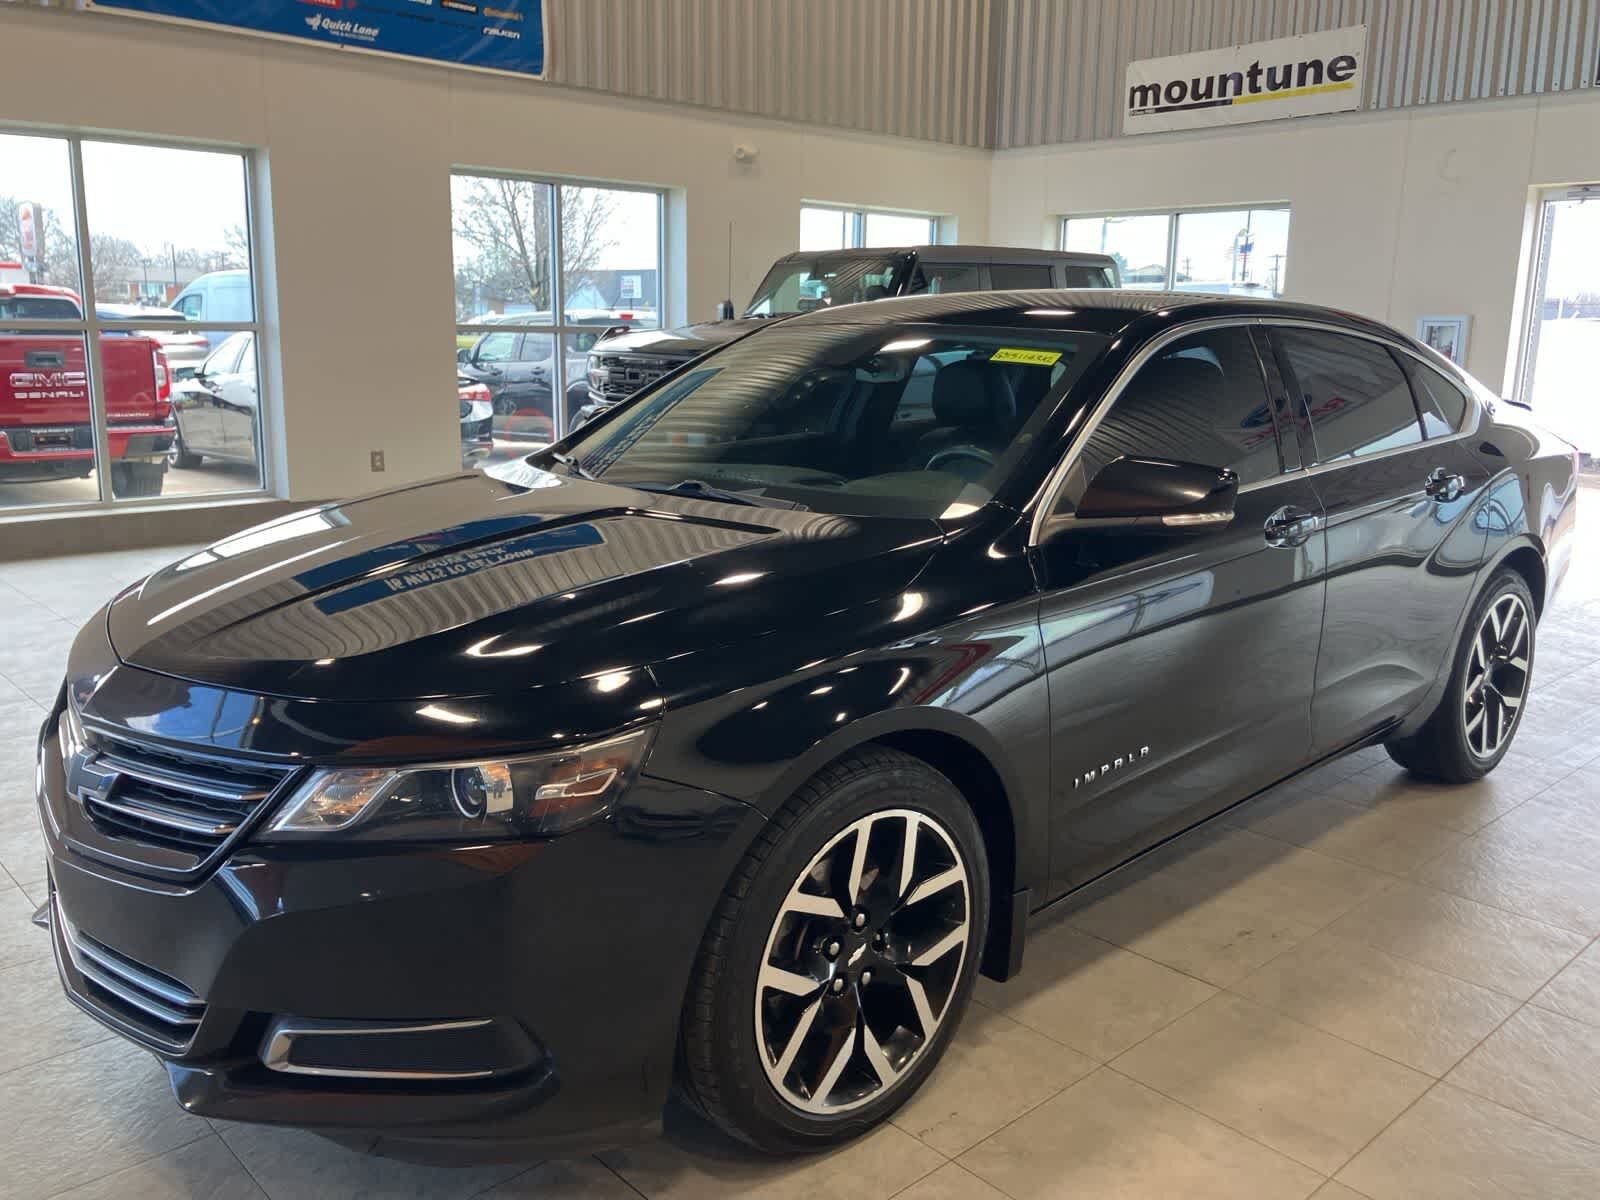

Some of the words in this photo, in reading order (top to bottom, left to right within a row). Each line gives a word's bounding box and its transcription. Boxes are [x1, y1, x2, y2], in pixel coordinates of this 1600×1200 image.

[321, 17, 352, 32] Quick
[352, 23, 380, 37] Lane
[1129, 54, 1357, 109] mountune
[9, 372, 87, 388] GMC
[14, 390, 85, 399] DENALI
[1073, 745, 1150, 790] IMPALA
